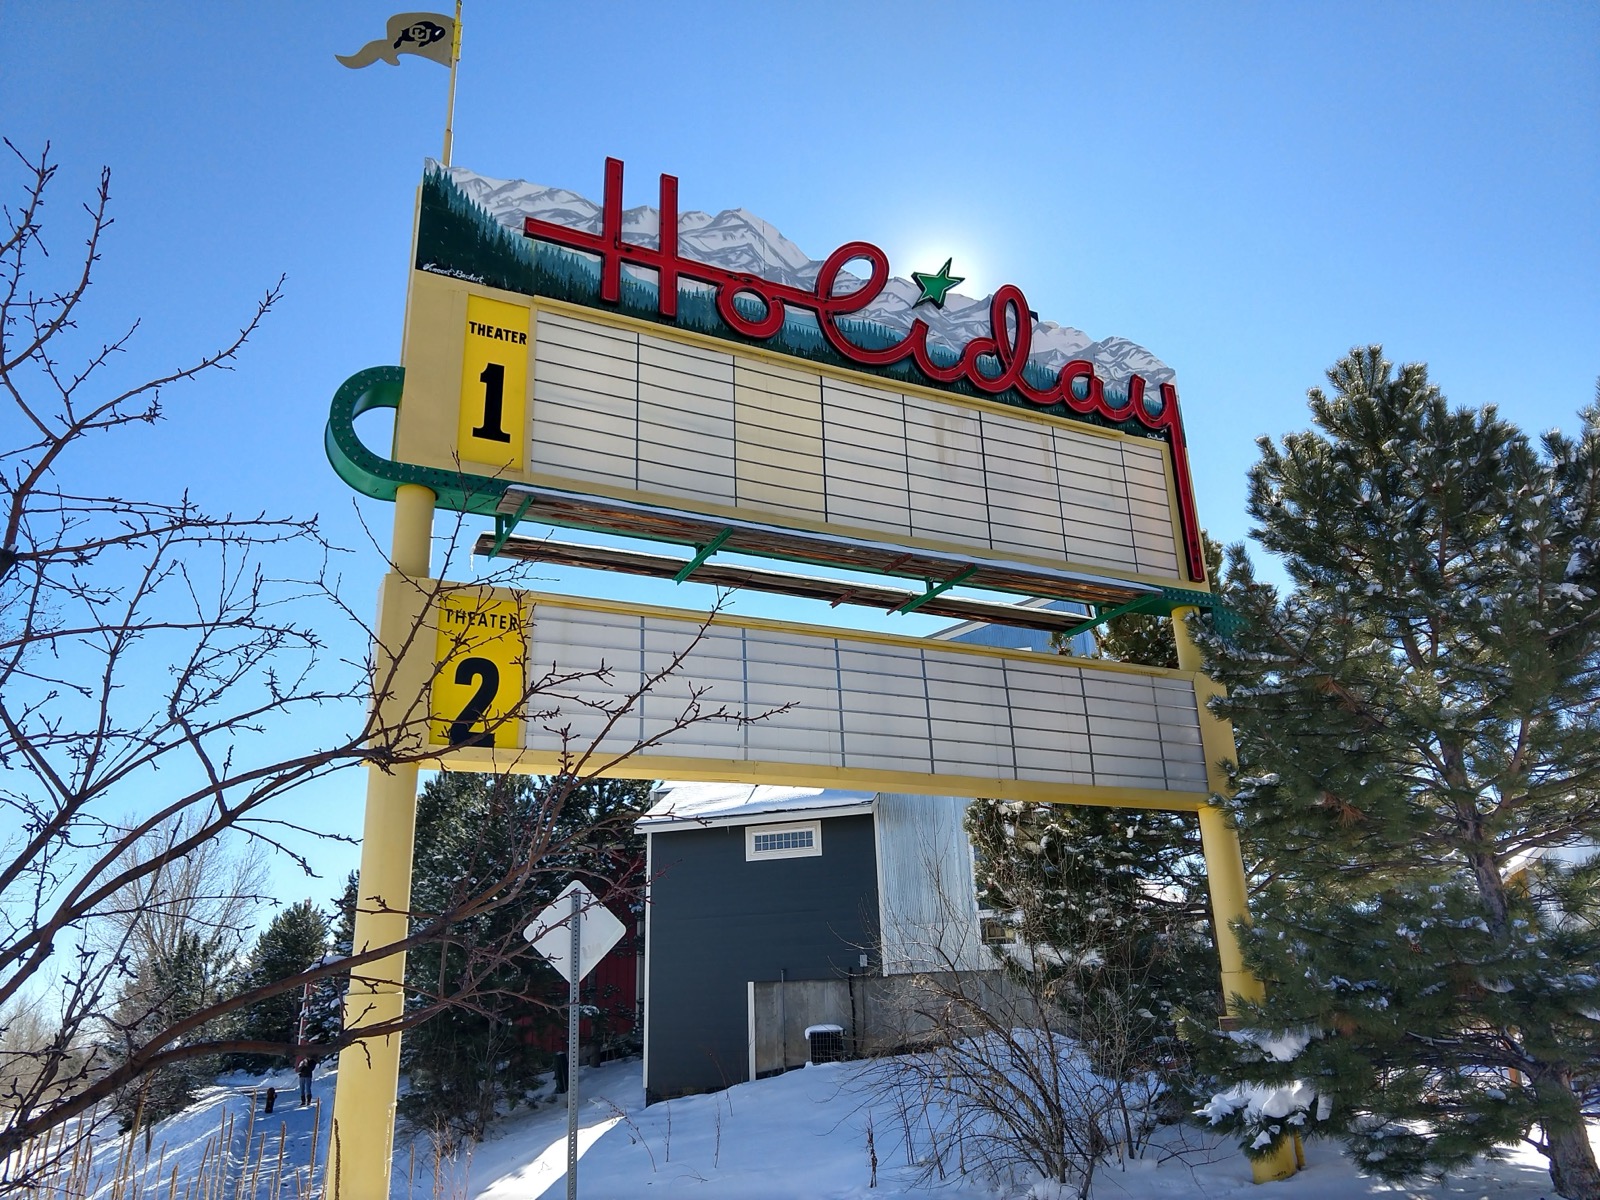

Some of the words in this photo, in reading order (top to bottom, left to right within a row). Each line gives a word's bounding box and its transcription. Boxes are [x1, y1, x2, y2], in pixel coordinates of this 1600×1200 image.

[469, 321, 527, 345] THEATER
[524, 157, 1205, 582] Holiday
[472, 363, 511, 443] 1
[446, 609, 518, 630] THEATER
[449, 657, 499, 747] 2
